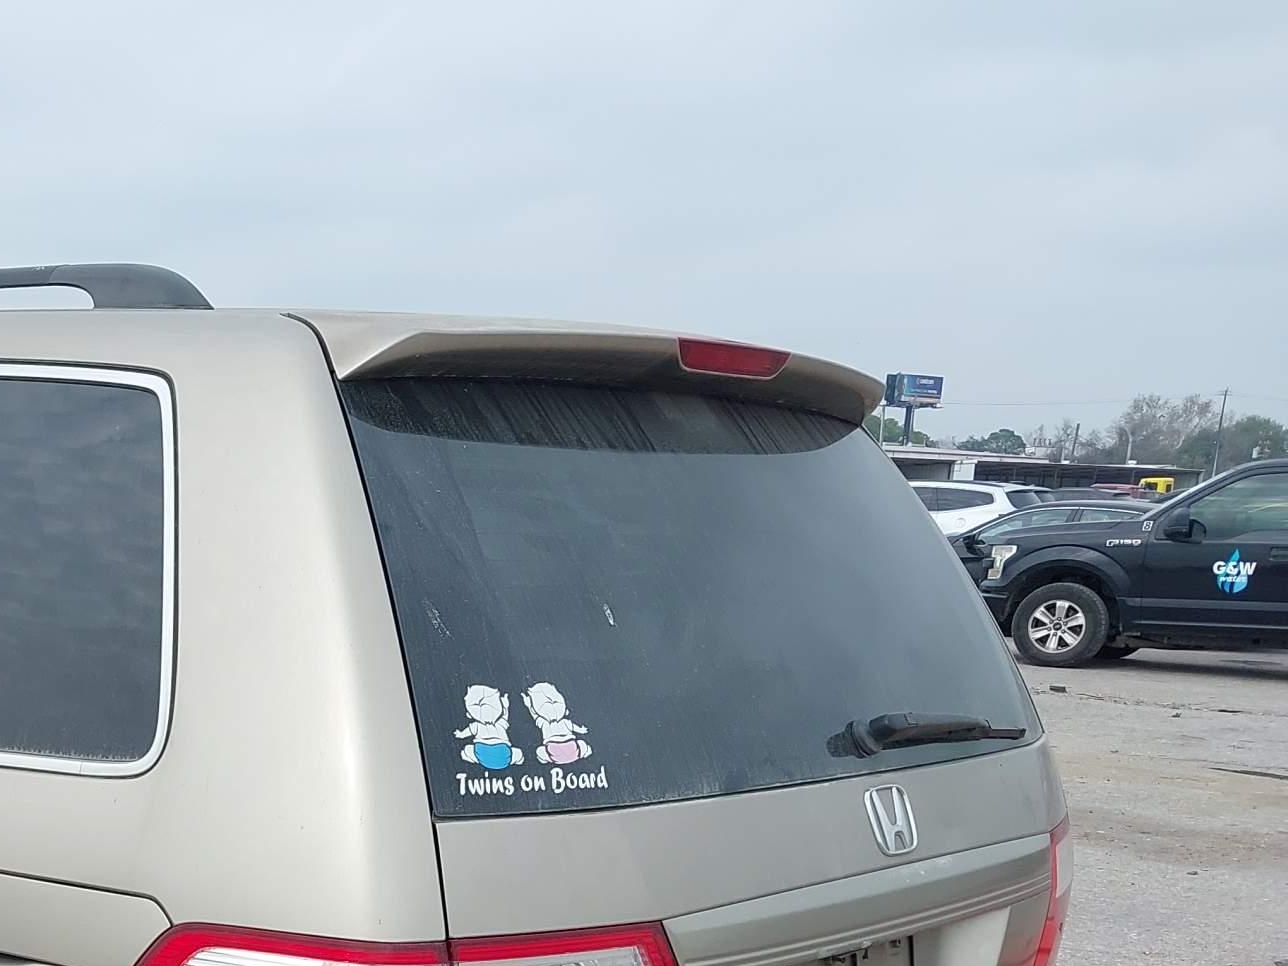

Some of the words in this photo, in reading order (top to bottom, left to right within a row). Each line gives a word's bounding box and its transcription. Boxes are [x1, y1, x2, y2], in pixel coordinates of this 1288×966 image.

[1213, 561, 1257, 575] G&W
[456, 772, 514, 795] Twins
[521, 775, 545, 794] on
[550, 766, 608, 794] Board
